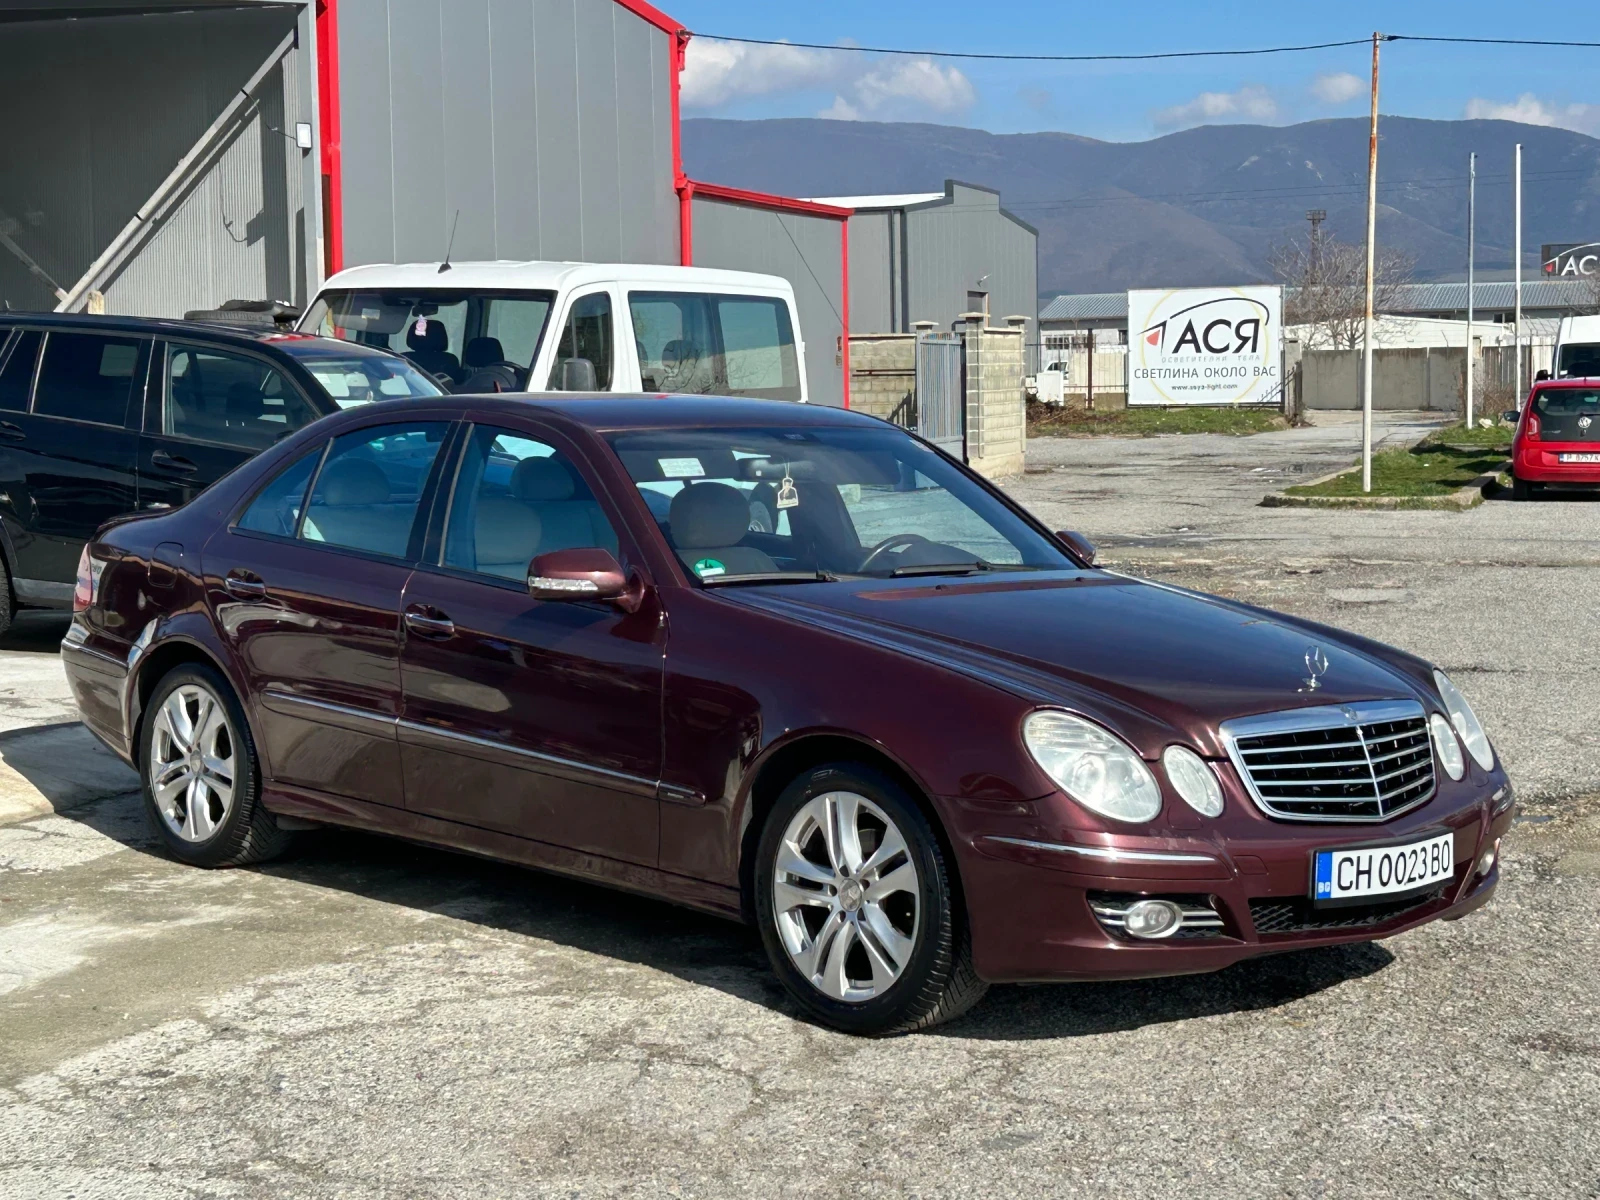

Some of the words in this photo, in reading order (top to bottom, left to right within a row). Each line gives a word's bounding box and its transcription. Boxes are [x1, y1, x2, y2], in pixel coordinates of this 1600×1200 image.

[1561, 254, 1600, 276] АС
[1171, 318, 1260, 354] АСЯ
[1161, 355, 1228, 363] ОСВЕТИТЕЛНИ
[1134, 368, 1199, 379] СВЕТЛИНА
[1204, 366, 1247, 378] ОКОЛО
[1253, 366, 1276, 377] ВАС
[1337, 855, 1373, 891] CH
[1378, 846, 1428, 887] 0023
